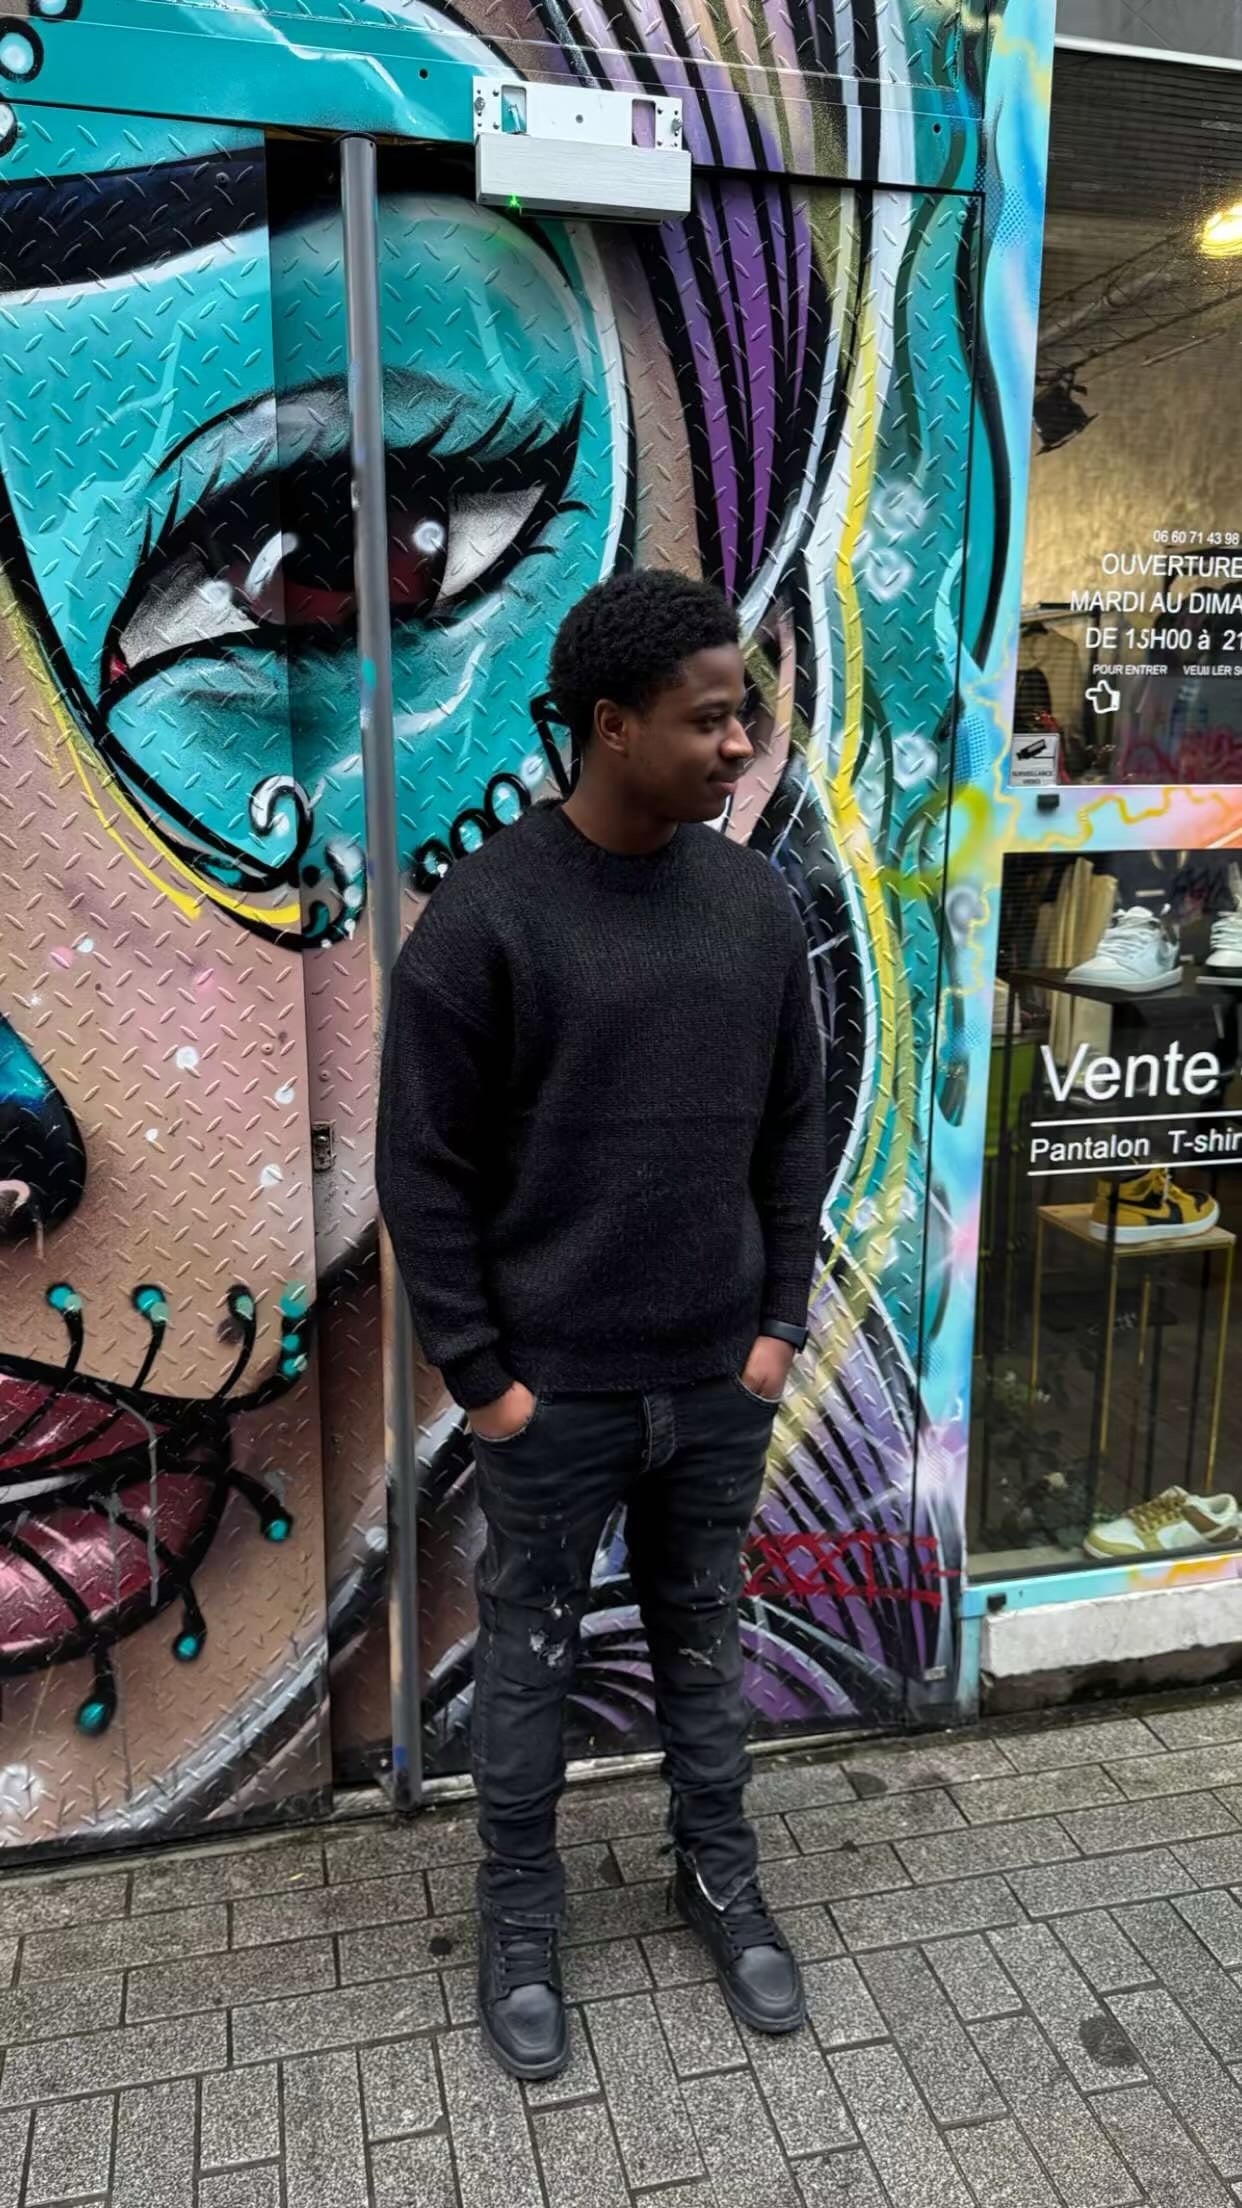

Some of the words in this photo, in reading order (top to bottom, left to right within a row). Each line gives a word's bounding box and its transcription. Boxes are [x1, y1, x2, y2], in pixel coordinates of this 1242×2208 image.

[1153, 530, 1168, 543] 06
[1171, 530, 1187, 544] 60
[1189, 531, 1203, 544] 71
[1206, 532, 1222, 545] 43
[1225, 532, 1240, 545] 98
[1102, 553, 1242, 578] OUVERTURE
[1070, 591, 1145, 613] MARDI
[1150, 592, 1182, 614] AU
[1085, 627, 1118, 649] DE
[1126, 628, 1192, 650] 15H00
[1197, 629, 1211, 650] à
[1092, 664, 1123, 675] POUR
[1125, 664, 1168, 676] ENTRER
[1041, 1041, 1220, 1101] Vente
[1030, 1133, 1149, 1163] Pantalon
